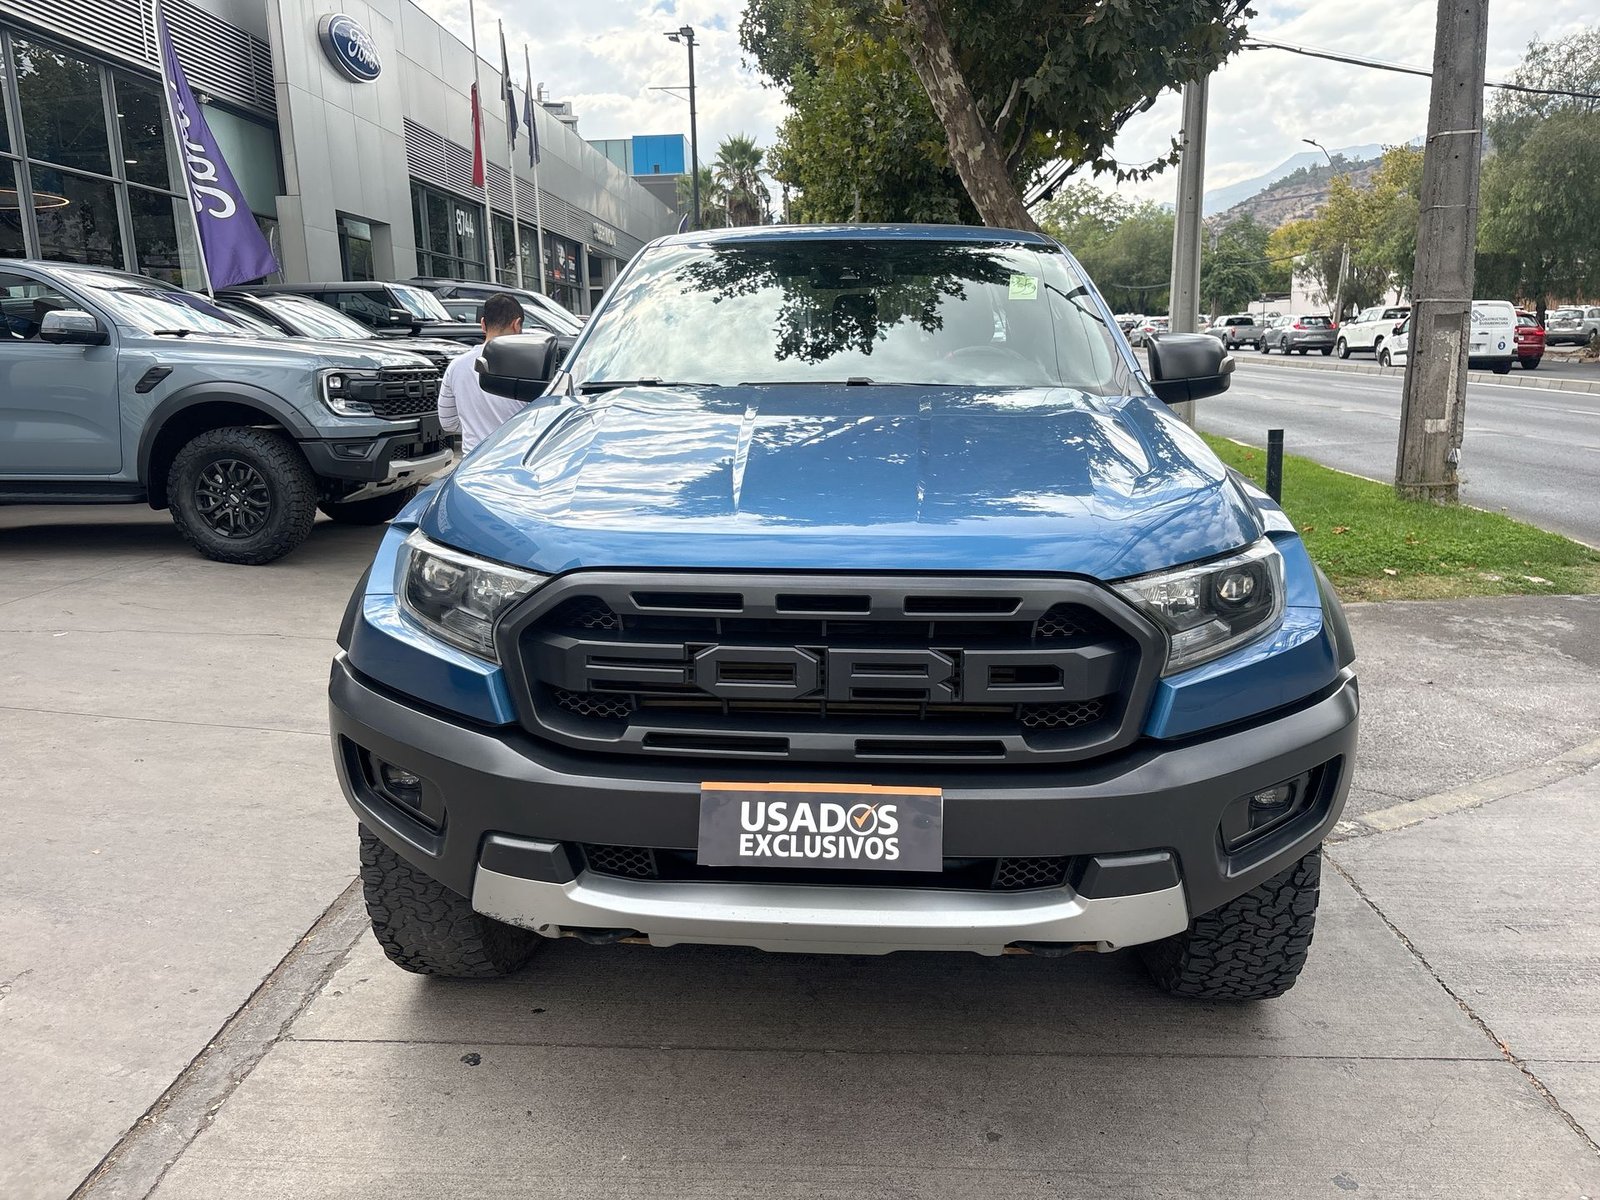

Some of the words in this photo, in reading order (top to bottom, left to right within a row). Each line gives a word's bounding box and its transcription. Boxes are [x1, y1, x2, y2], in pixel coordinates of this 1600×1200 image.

[347, 28, 381, 70] Ford
[455, 208, 475, 239] 8744
[579, 639, 1088, 702] FORD
[740, 801, 899, 836] USADOS
[739, 833, 900, 861] EXCLUSIVOS
